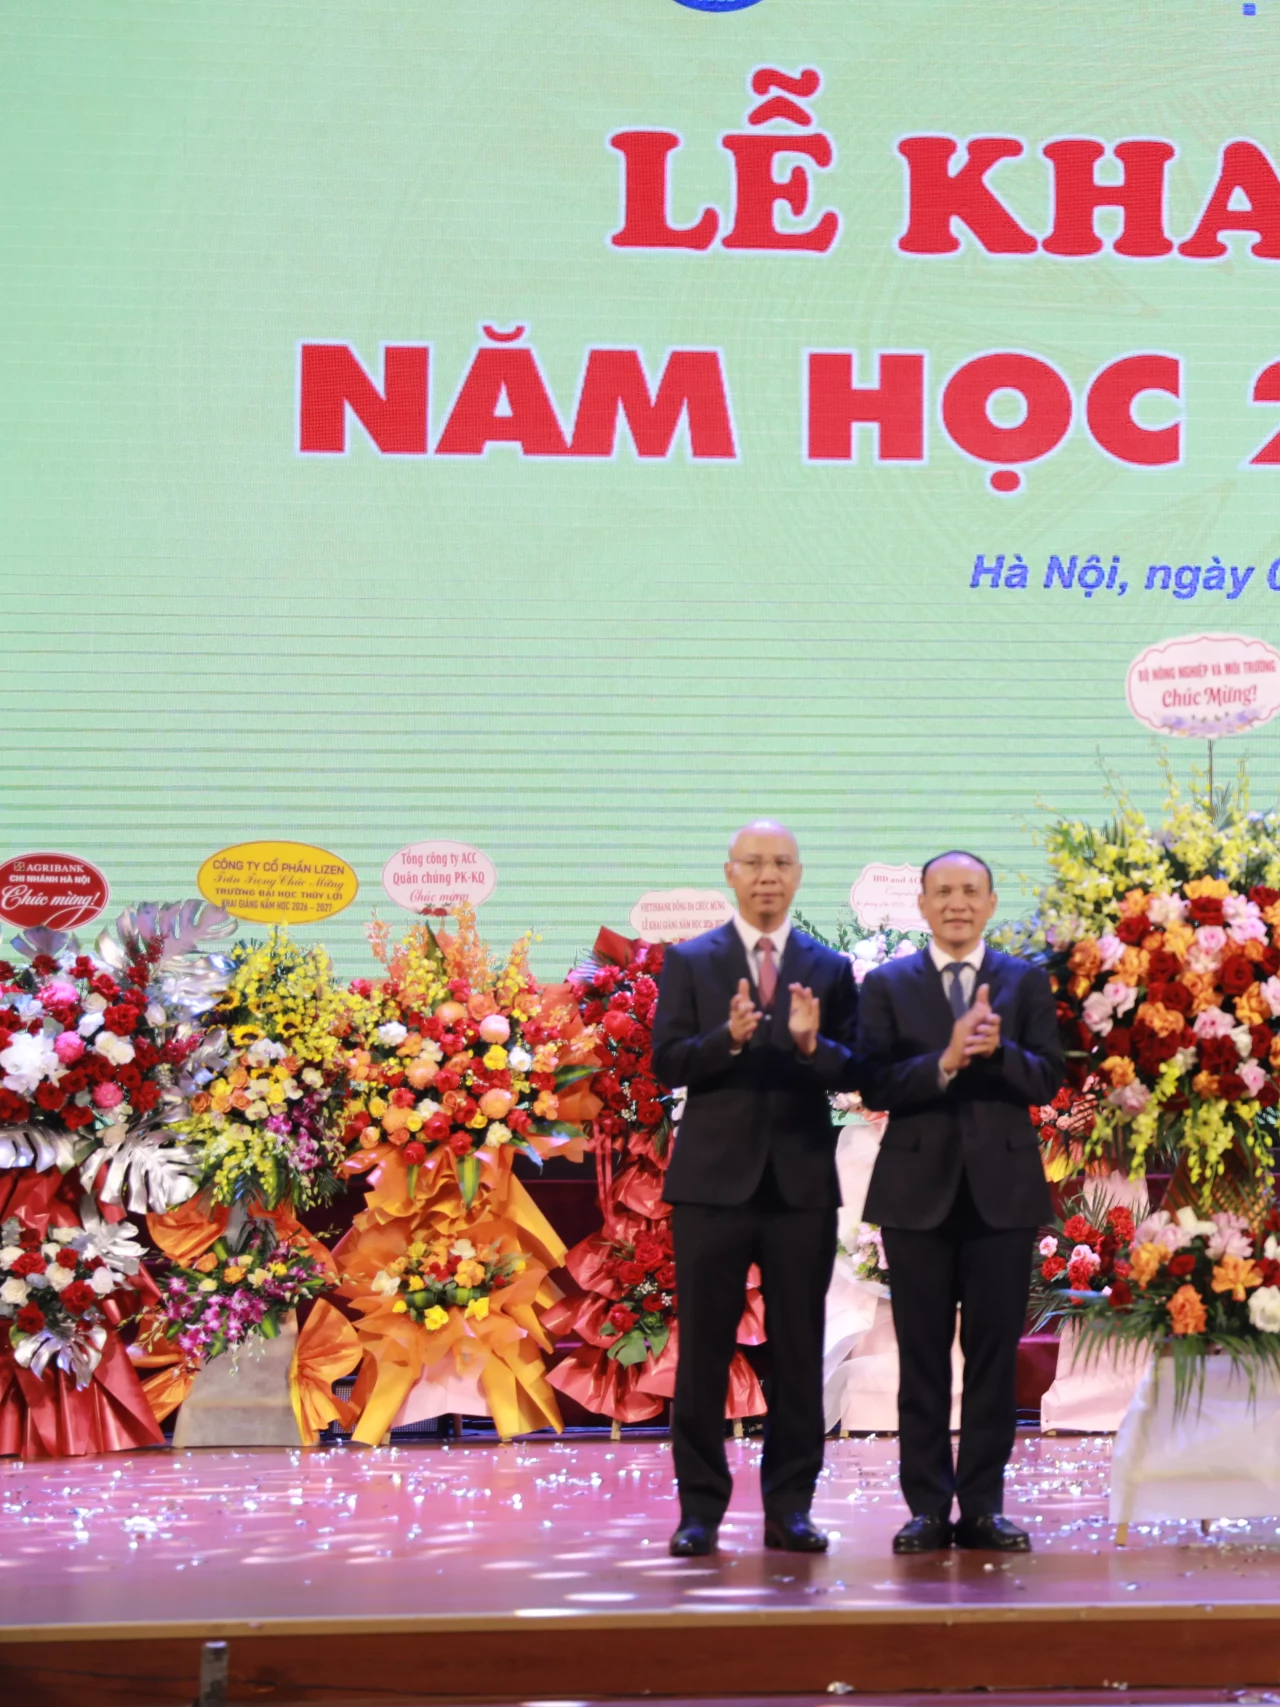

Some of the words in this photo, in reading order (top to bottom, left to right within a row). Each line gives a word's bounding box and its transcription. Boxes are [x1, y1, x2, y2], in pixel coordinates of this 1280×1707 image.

[610, 67, 840, 254] LỄ
[298, 324, 737, 460] NĂM
[806, 353, 1182, 492] HỌC
[969, 554, 1029, 589] Hà
[1043, 554, 1128, 598] Nội,
[1144, 556, 1255, 600] ngày
[1161, 687, 1201, 708] Chúc
[1203, 684, 1258, 708] Mừng!
[212, 857, 244, 871] CÔNG
[247, 862, 261, 872] TY
[263, 858, 279, 872] CỔ
[314, 864, 345, 875] LIZEN
[401, 849, 424, 868] Tổng
[426, 851, 448, 868] công
[450, 852, 459, 867] ty
[461, 852, 477, 864] ACC
[27, 863, 84, 873] AGRIBANK
[9, 874, 26, 883] CHI
[26, 873, 59, 884] NHÁNH
[60, 874, 73, 884] HÀ
[74, 874, 91, 886] NỘI
[393, 870, 418, 886] Quân
[454, 871, 486, 885] PK-KQ
[1, 884, 49, 911] Chúc
[215, 886, 256, 897] TRƯỜNG
[409, 889, 437, 903] Chúc
[291, 901, 308, 912] 2026
[315, 902, 333, 913] 2027
